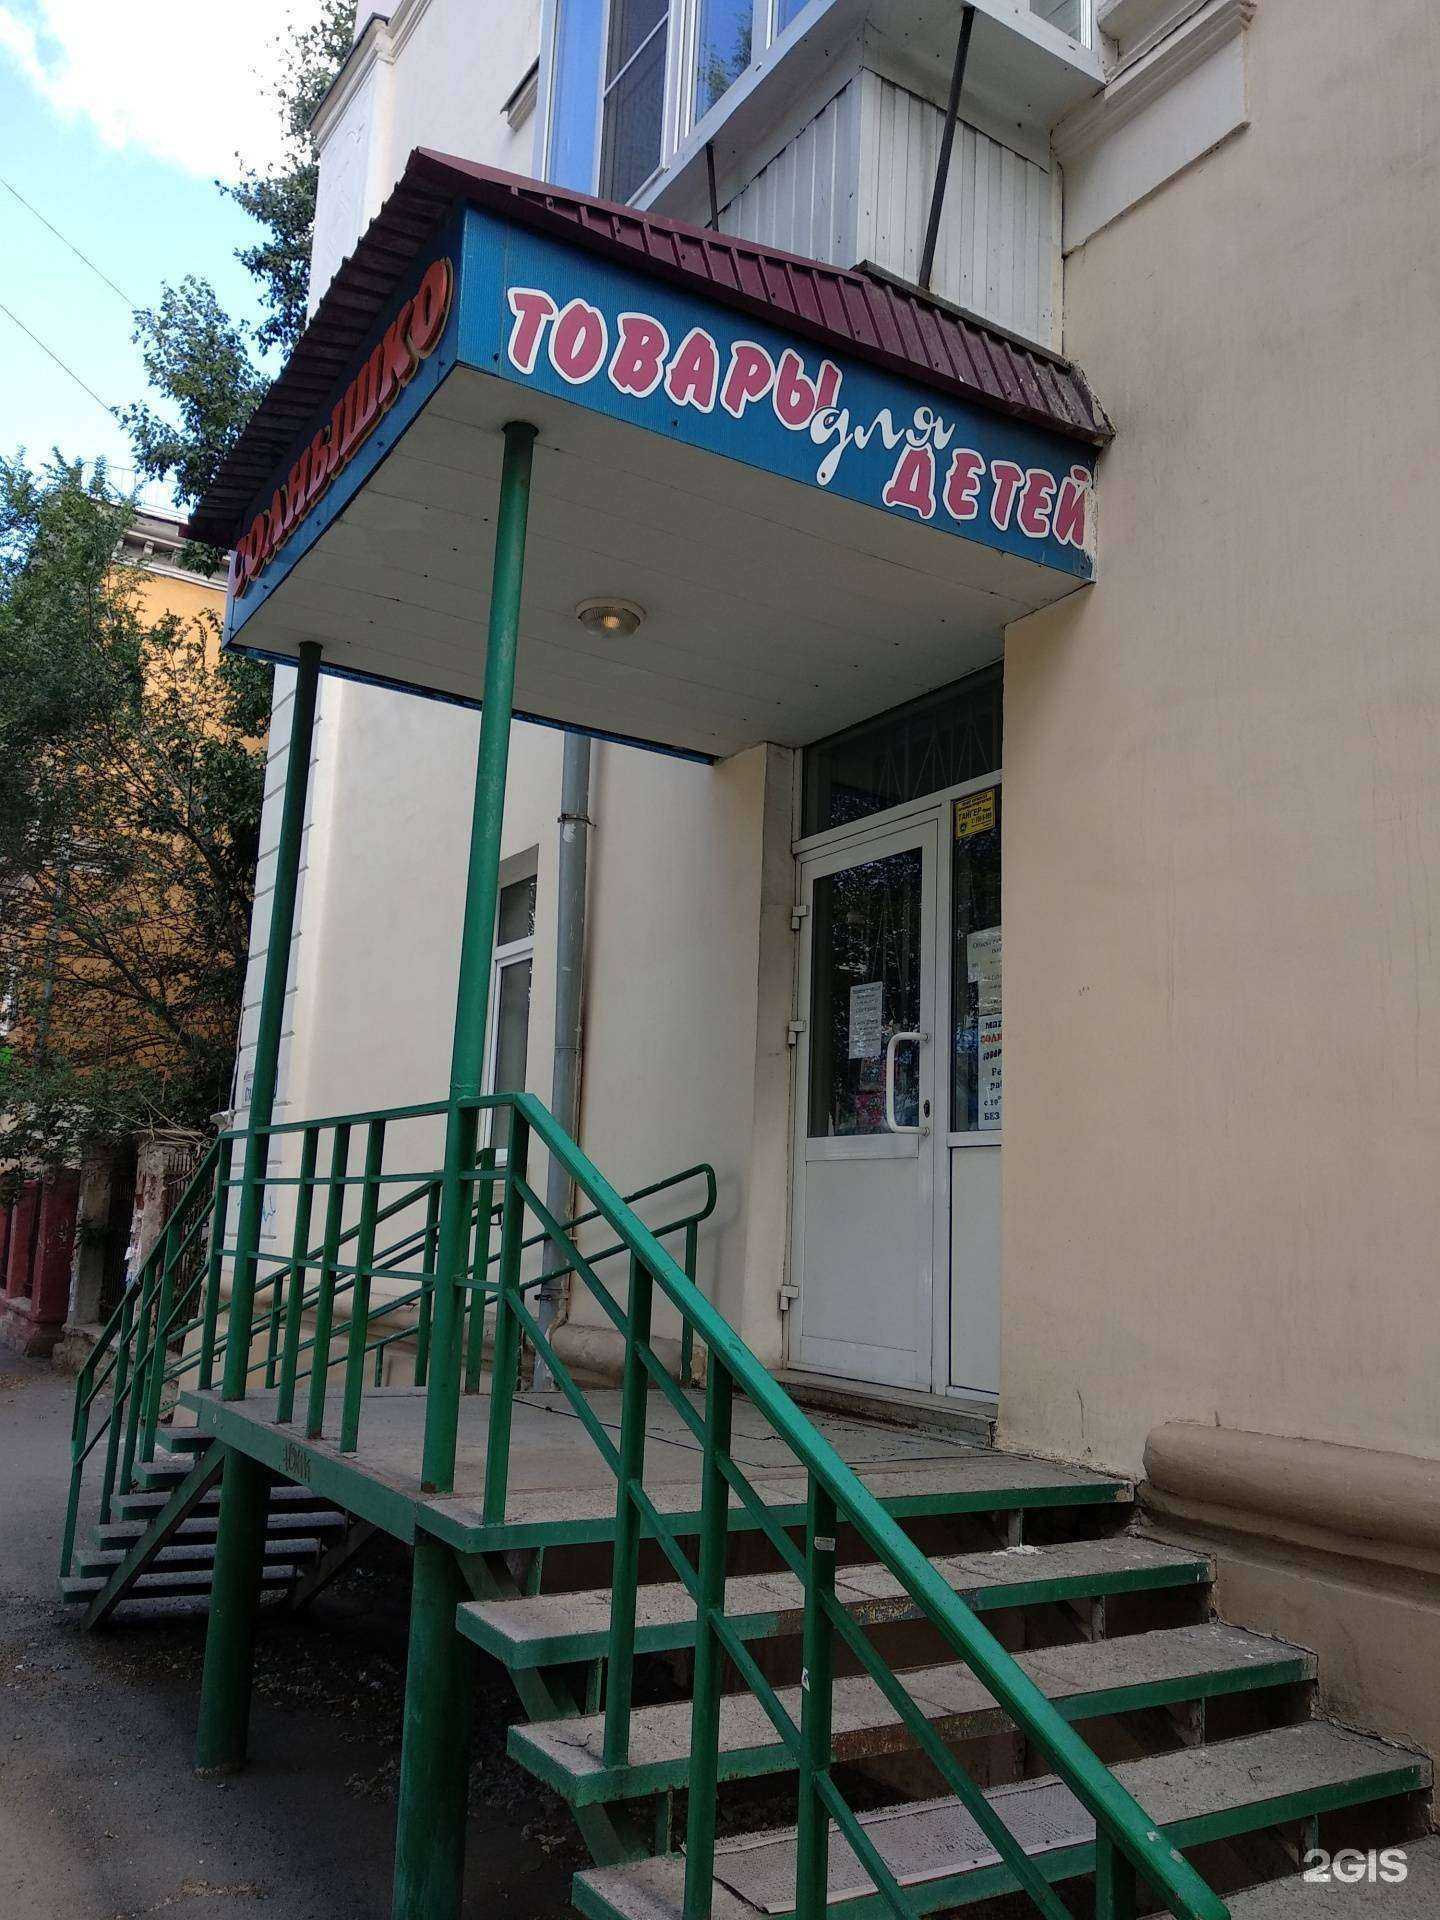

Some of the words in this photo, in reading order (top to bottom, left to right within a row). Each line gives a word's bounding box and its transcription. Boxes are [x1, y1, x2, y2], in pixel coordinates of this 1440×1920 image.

[507, 286, 842, 430] ТОВАРЫ
[811, 404, 955, 486] для
[883, 442, 1091, 548] ДЕТЕЙ
